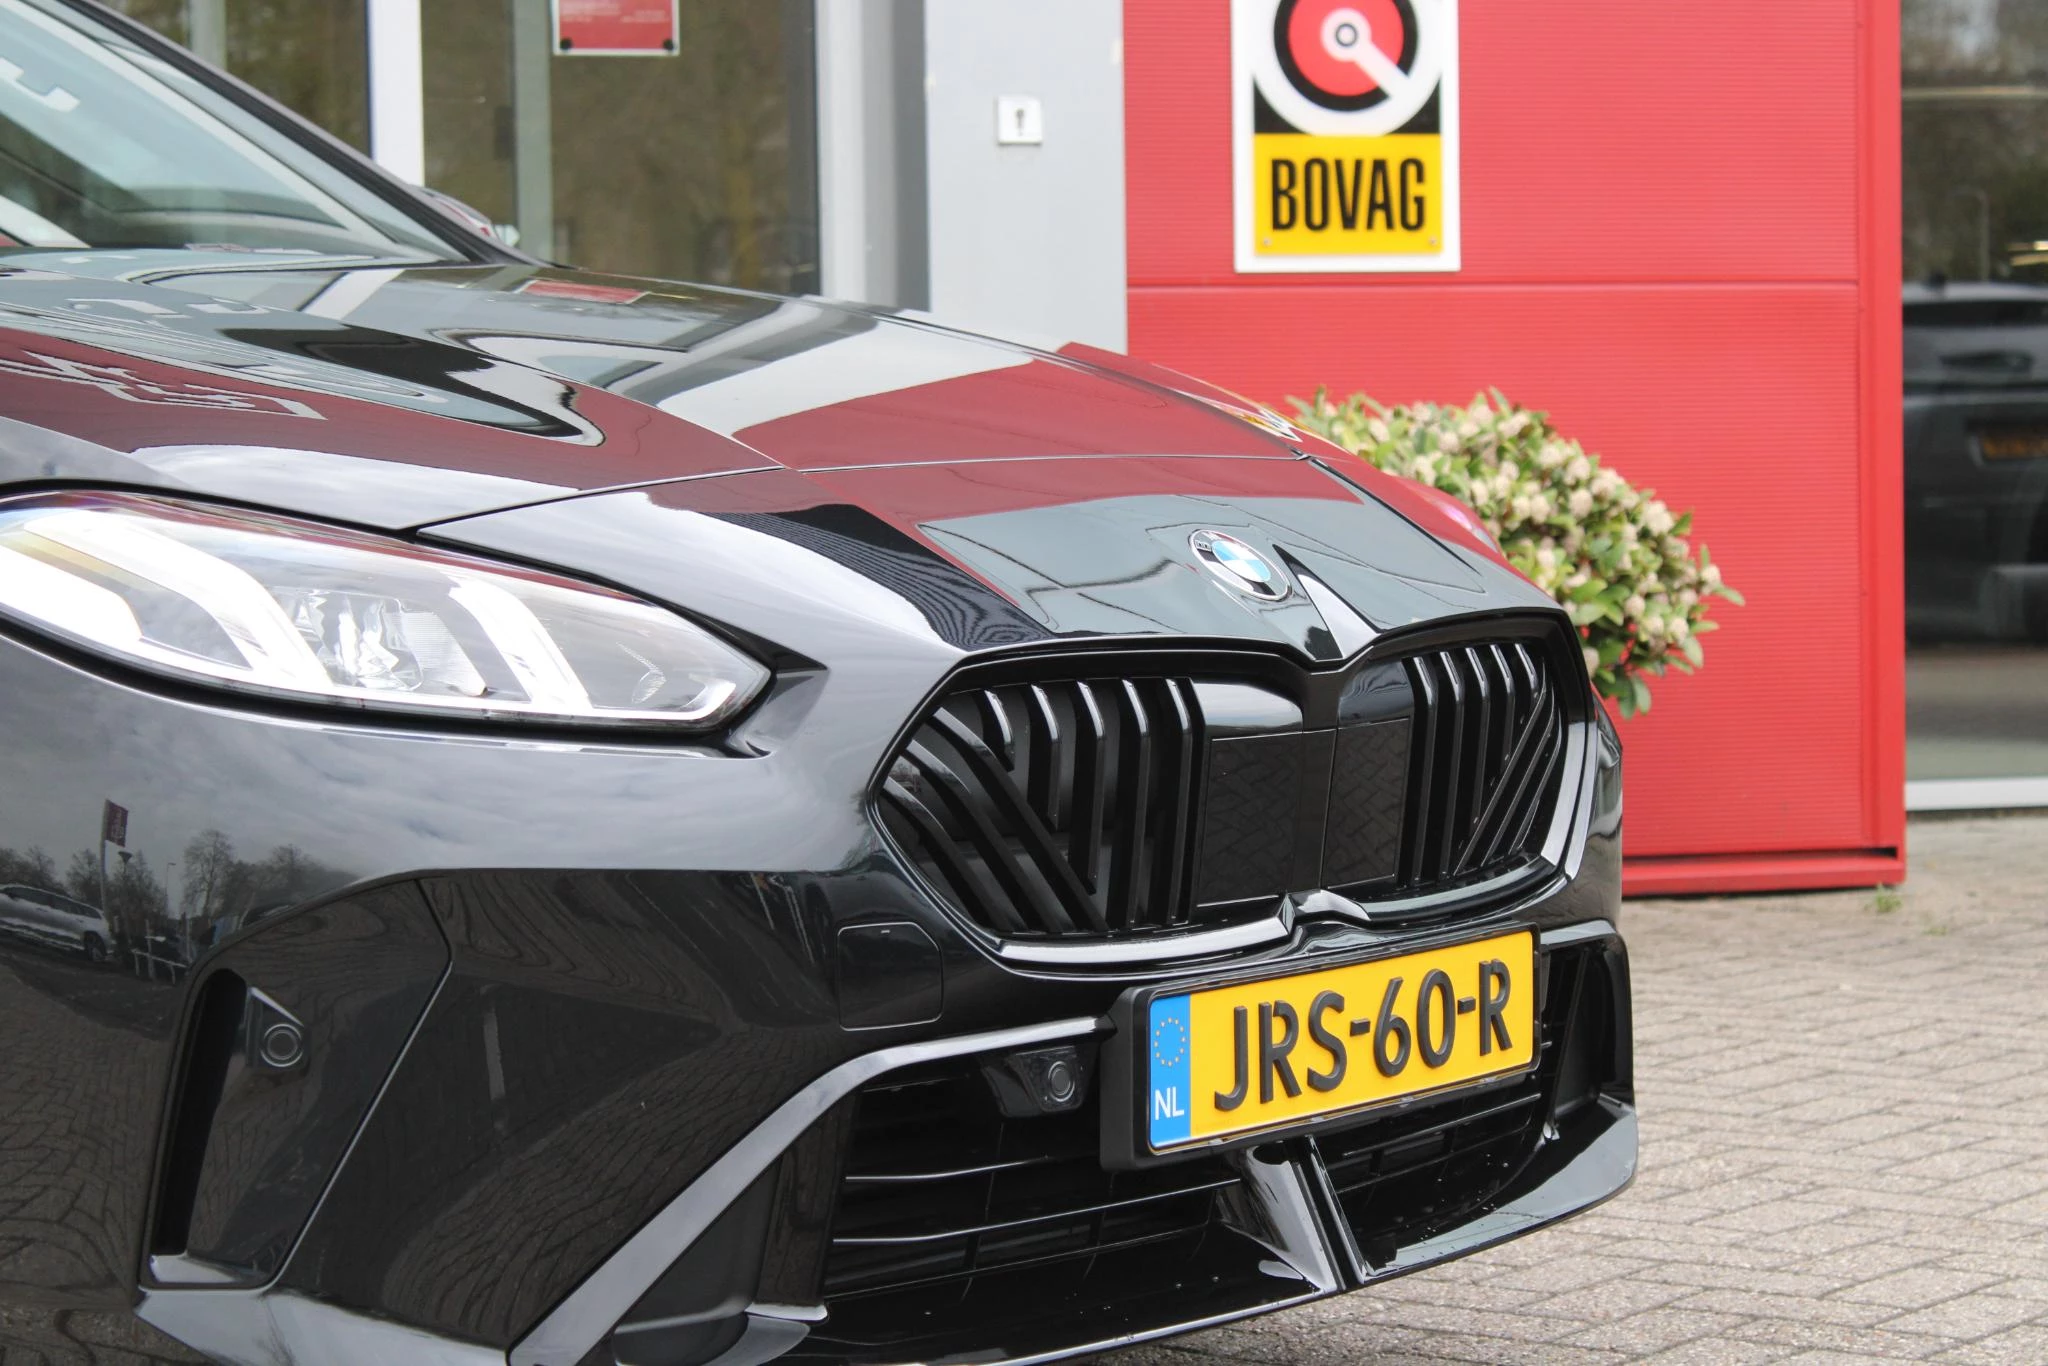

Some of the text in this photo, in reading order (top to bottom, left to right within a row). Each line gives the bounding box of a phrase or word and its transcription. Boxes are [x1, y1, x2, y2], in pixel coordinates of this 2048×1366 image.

[1271, 157, 1425, 232] BOVAG
[1214, 958, 1512, 1112] JRS-60-R
[1155, 1086, 1185, 1120] NL
